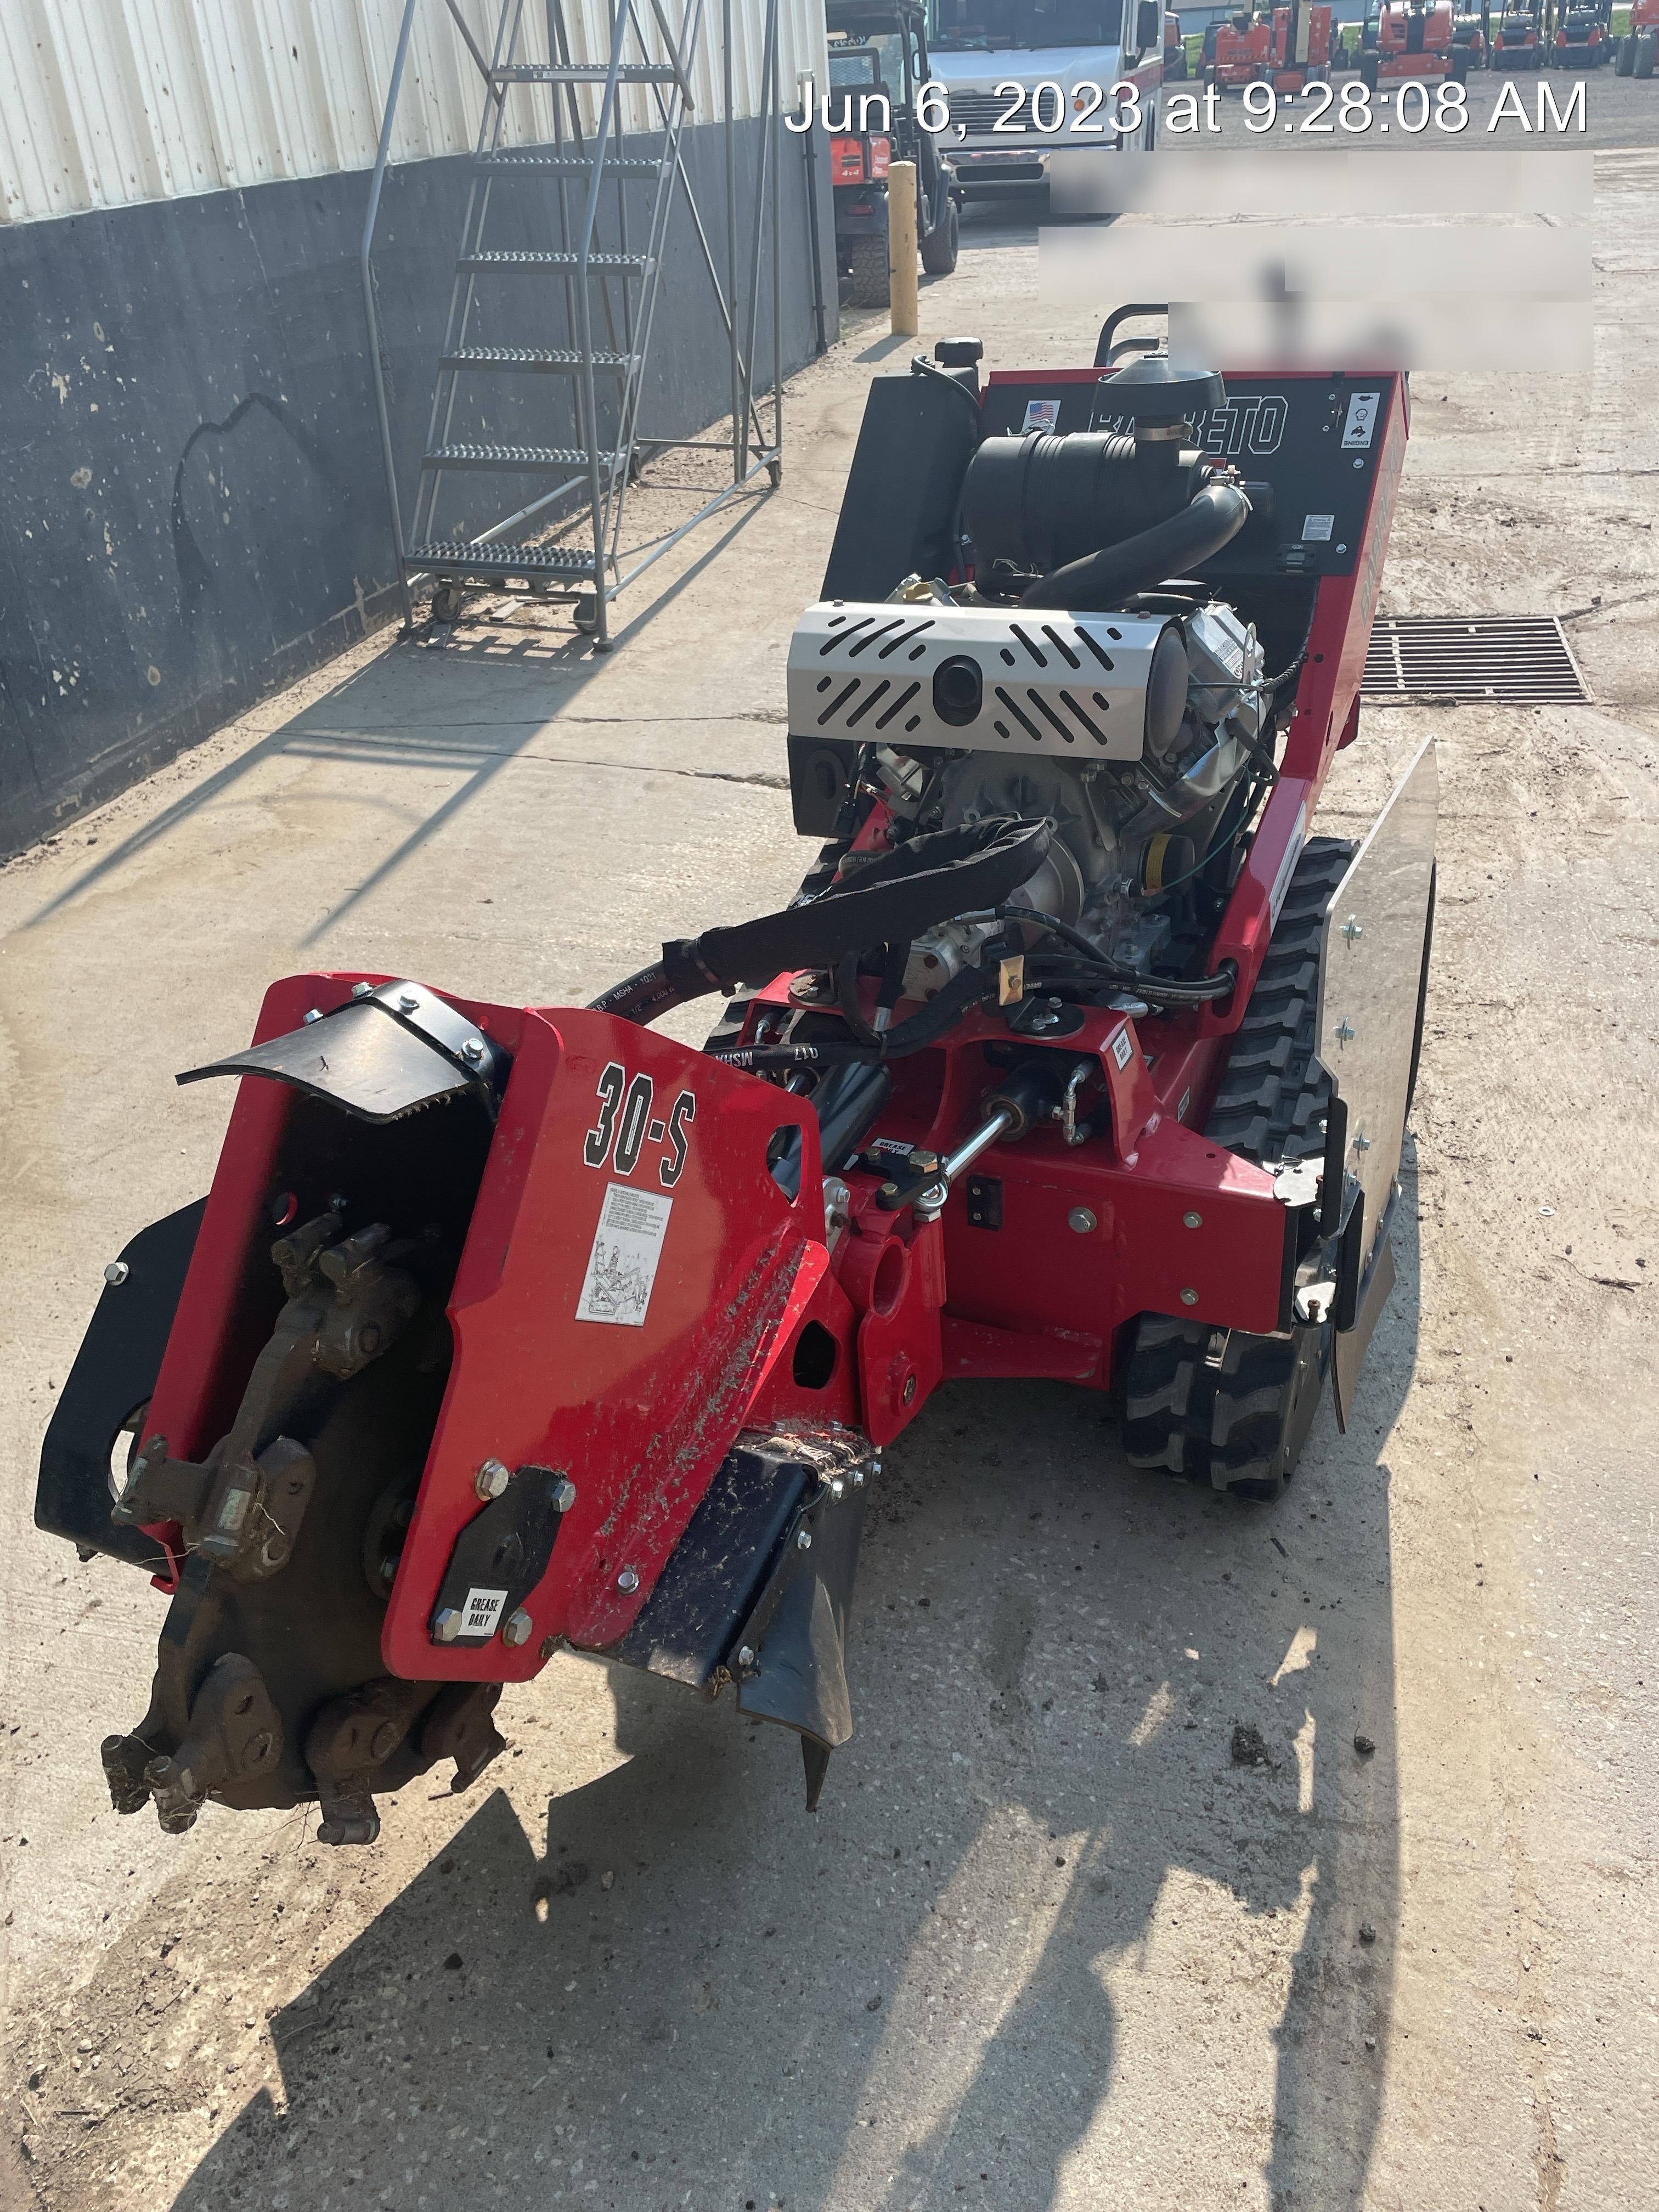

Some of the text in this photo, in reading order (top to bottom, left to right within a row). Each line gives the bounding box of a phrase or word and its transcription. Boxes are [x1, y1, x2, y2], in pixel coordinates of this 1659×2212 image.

[613, 985, 634, 1001] MSHA
[584, 1061, 696, 1188] 30-S
[879, 1142, 907, 1150] GREASE
[471, 1598, 500, 1612] GREASE
[468, 1613, 491, 1627] DAILY
